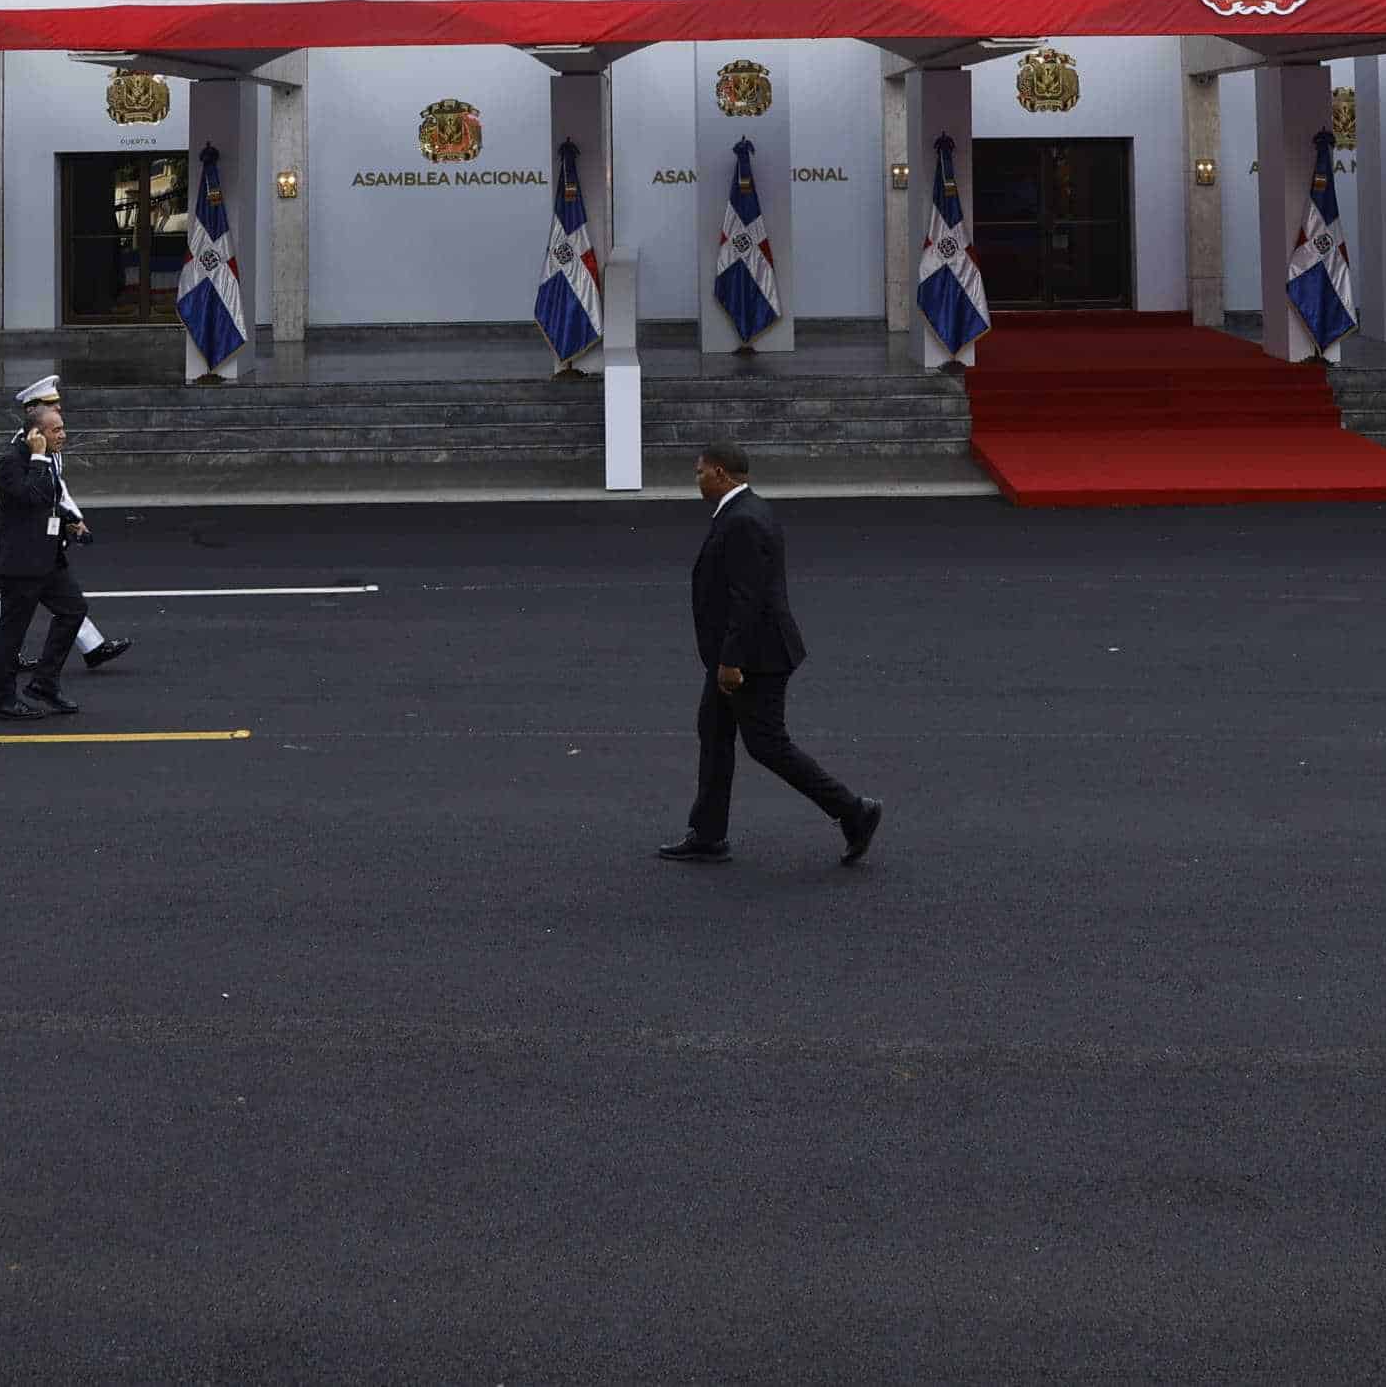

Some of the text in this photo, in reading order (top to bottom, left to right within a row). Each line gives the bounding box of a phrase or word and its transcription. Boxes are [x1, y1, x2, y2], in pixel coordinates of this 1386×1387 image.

[351, 170, 549, 186] ASAMBLEA NACIONAL
[792, 167, 849, 182] IONAL
